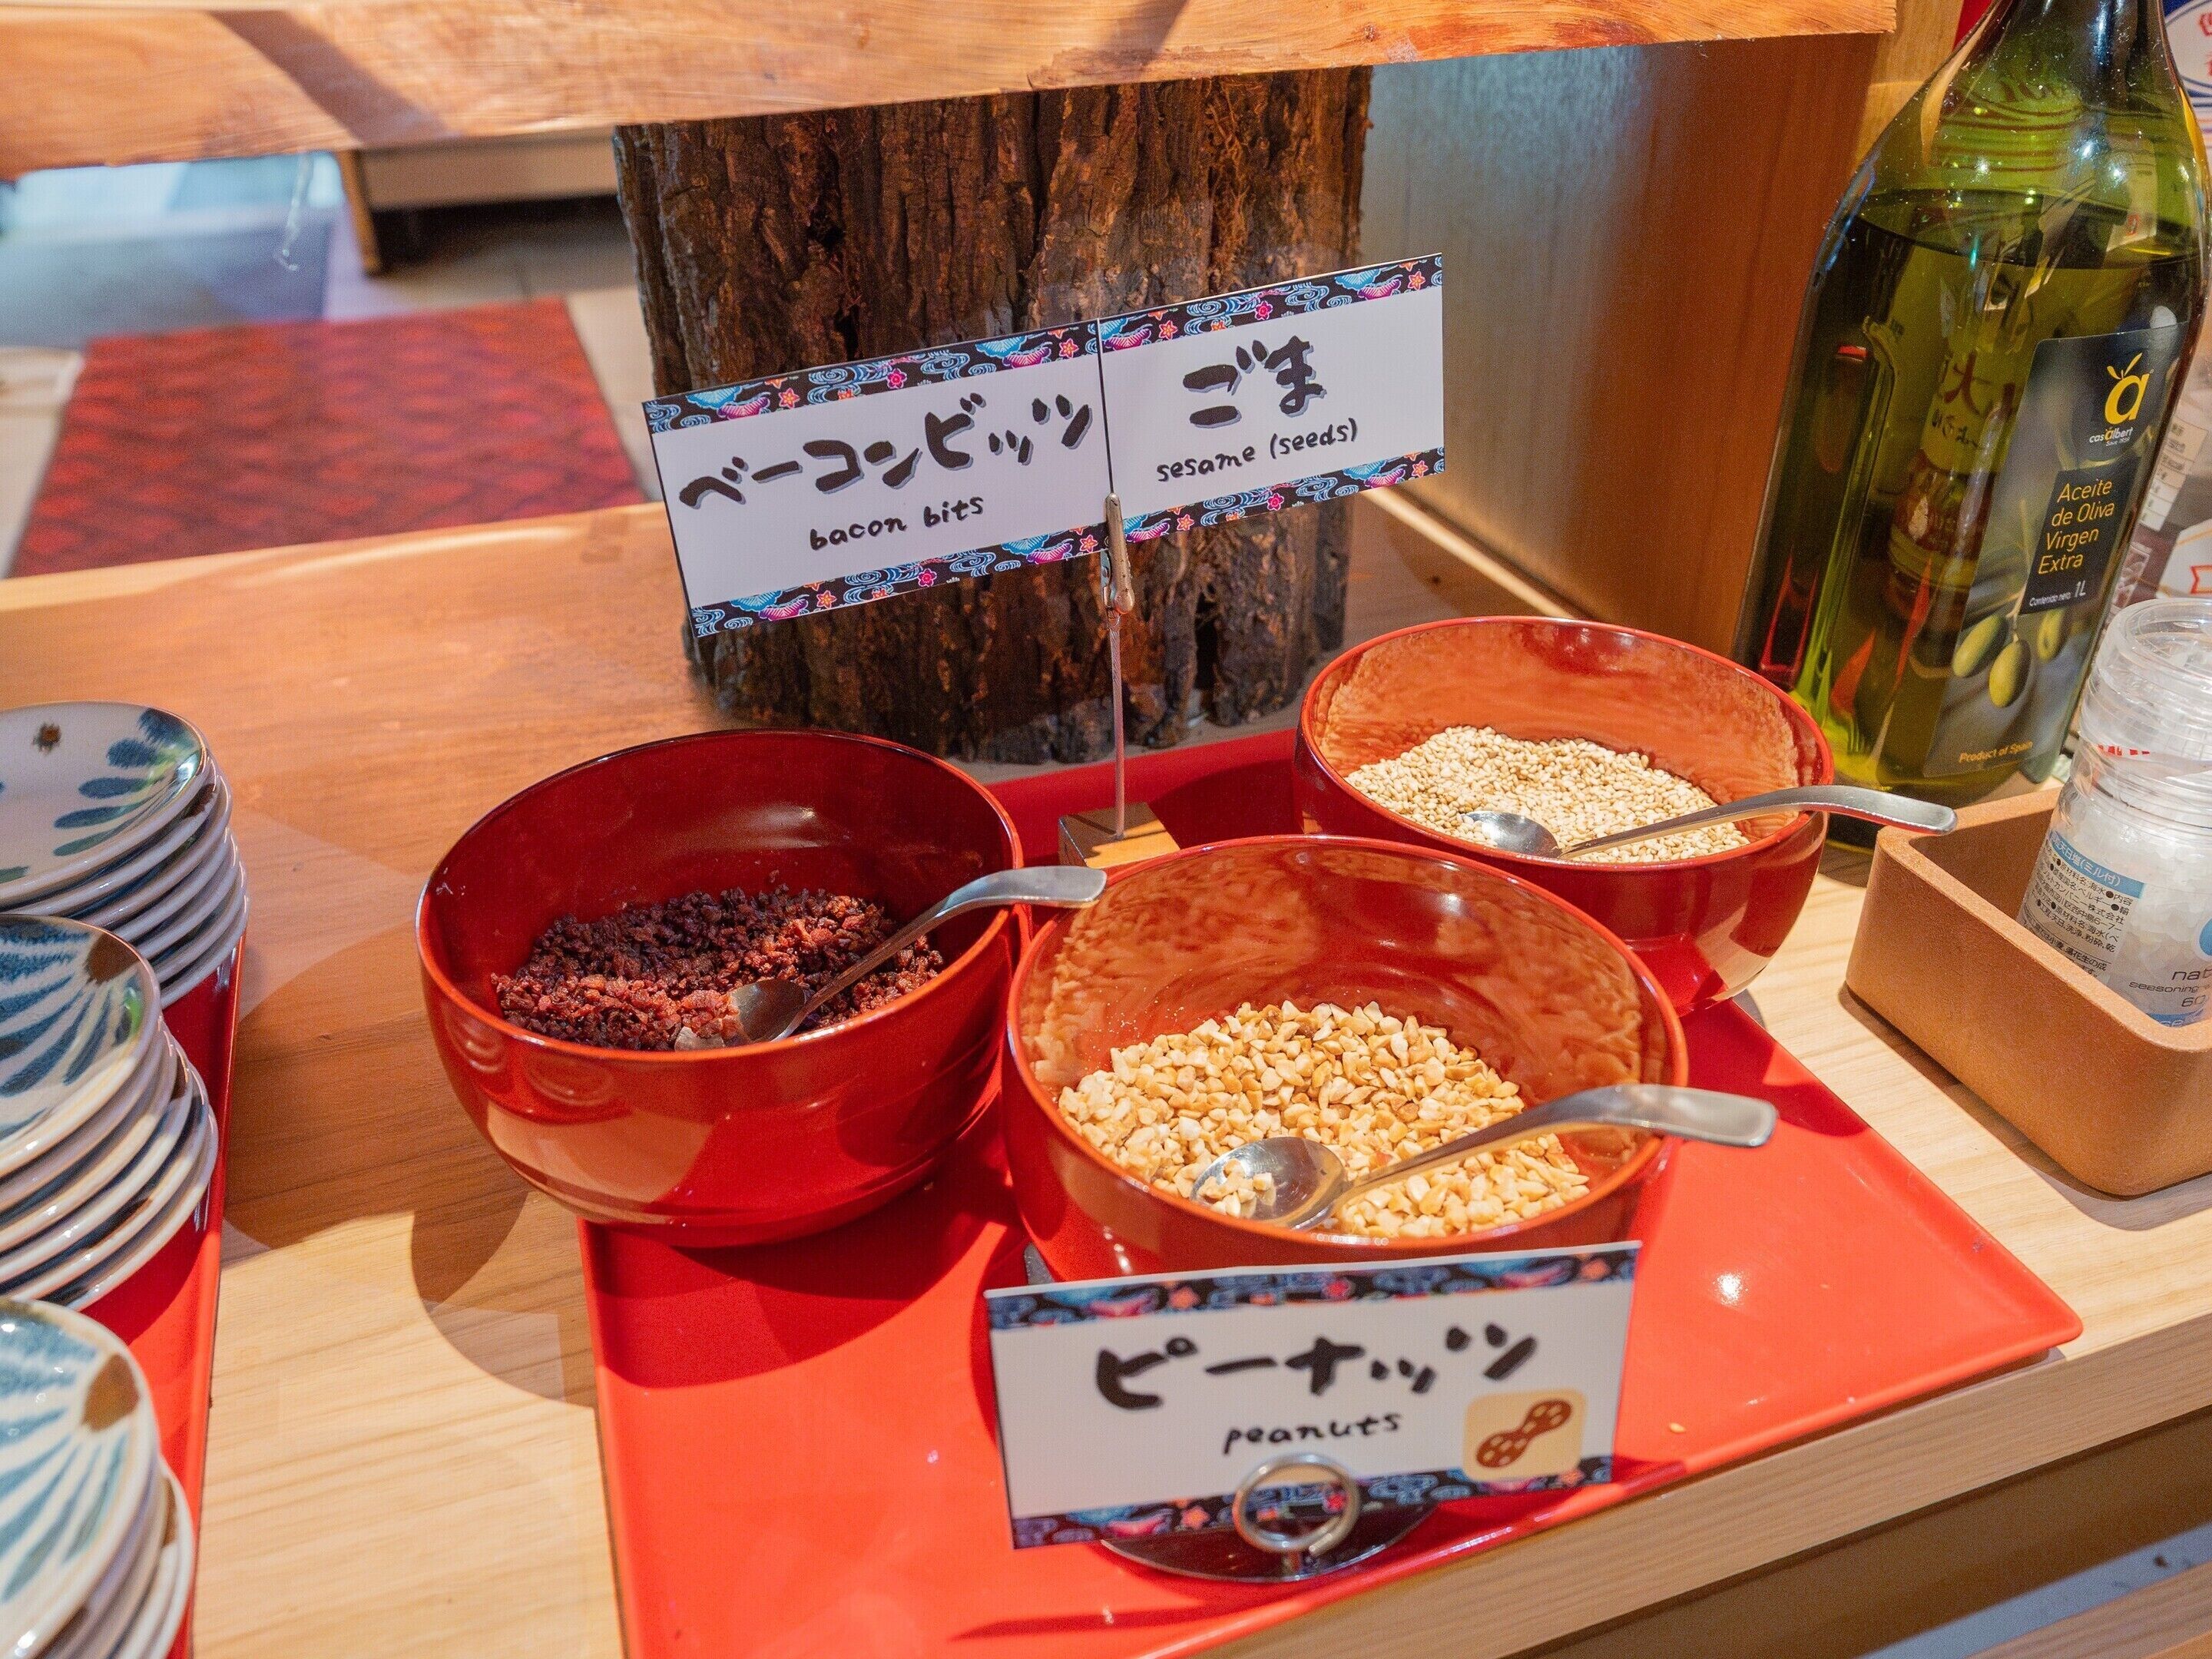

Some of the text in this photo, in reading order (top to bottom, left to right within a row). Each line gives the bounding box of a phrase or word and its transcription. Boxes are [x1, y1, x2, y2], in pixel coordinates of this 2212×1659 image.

[1184, 336, 1327, 429] ごま
[680, 392, 1092, 509] ベーコンビッツ
[1157, 417, 1359, 482] sesame (seeds)
[2057, 478, 2113, 503] Aceite
[810, 496, 984, 551] bacon bits
[2051, 501, 2115, 527] de Oliva
[2046, 528, 2099, 552] Virgen
[2038, 554, 2084, 575] Extra
[2075, 580, 2087, 598] 1L
[1959, 740, 2034, 763] Product of Spain
[1095, 1323, 1537, 1412] ピーナッツ
[1224, 1412, 1402, 1455] peanuts
